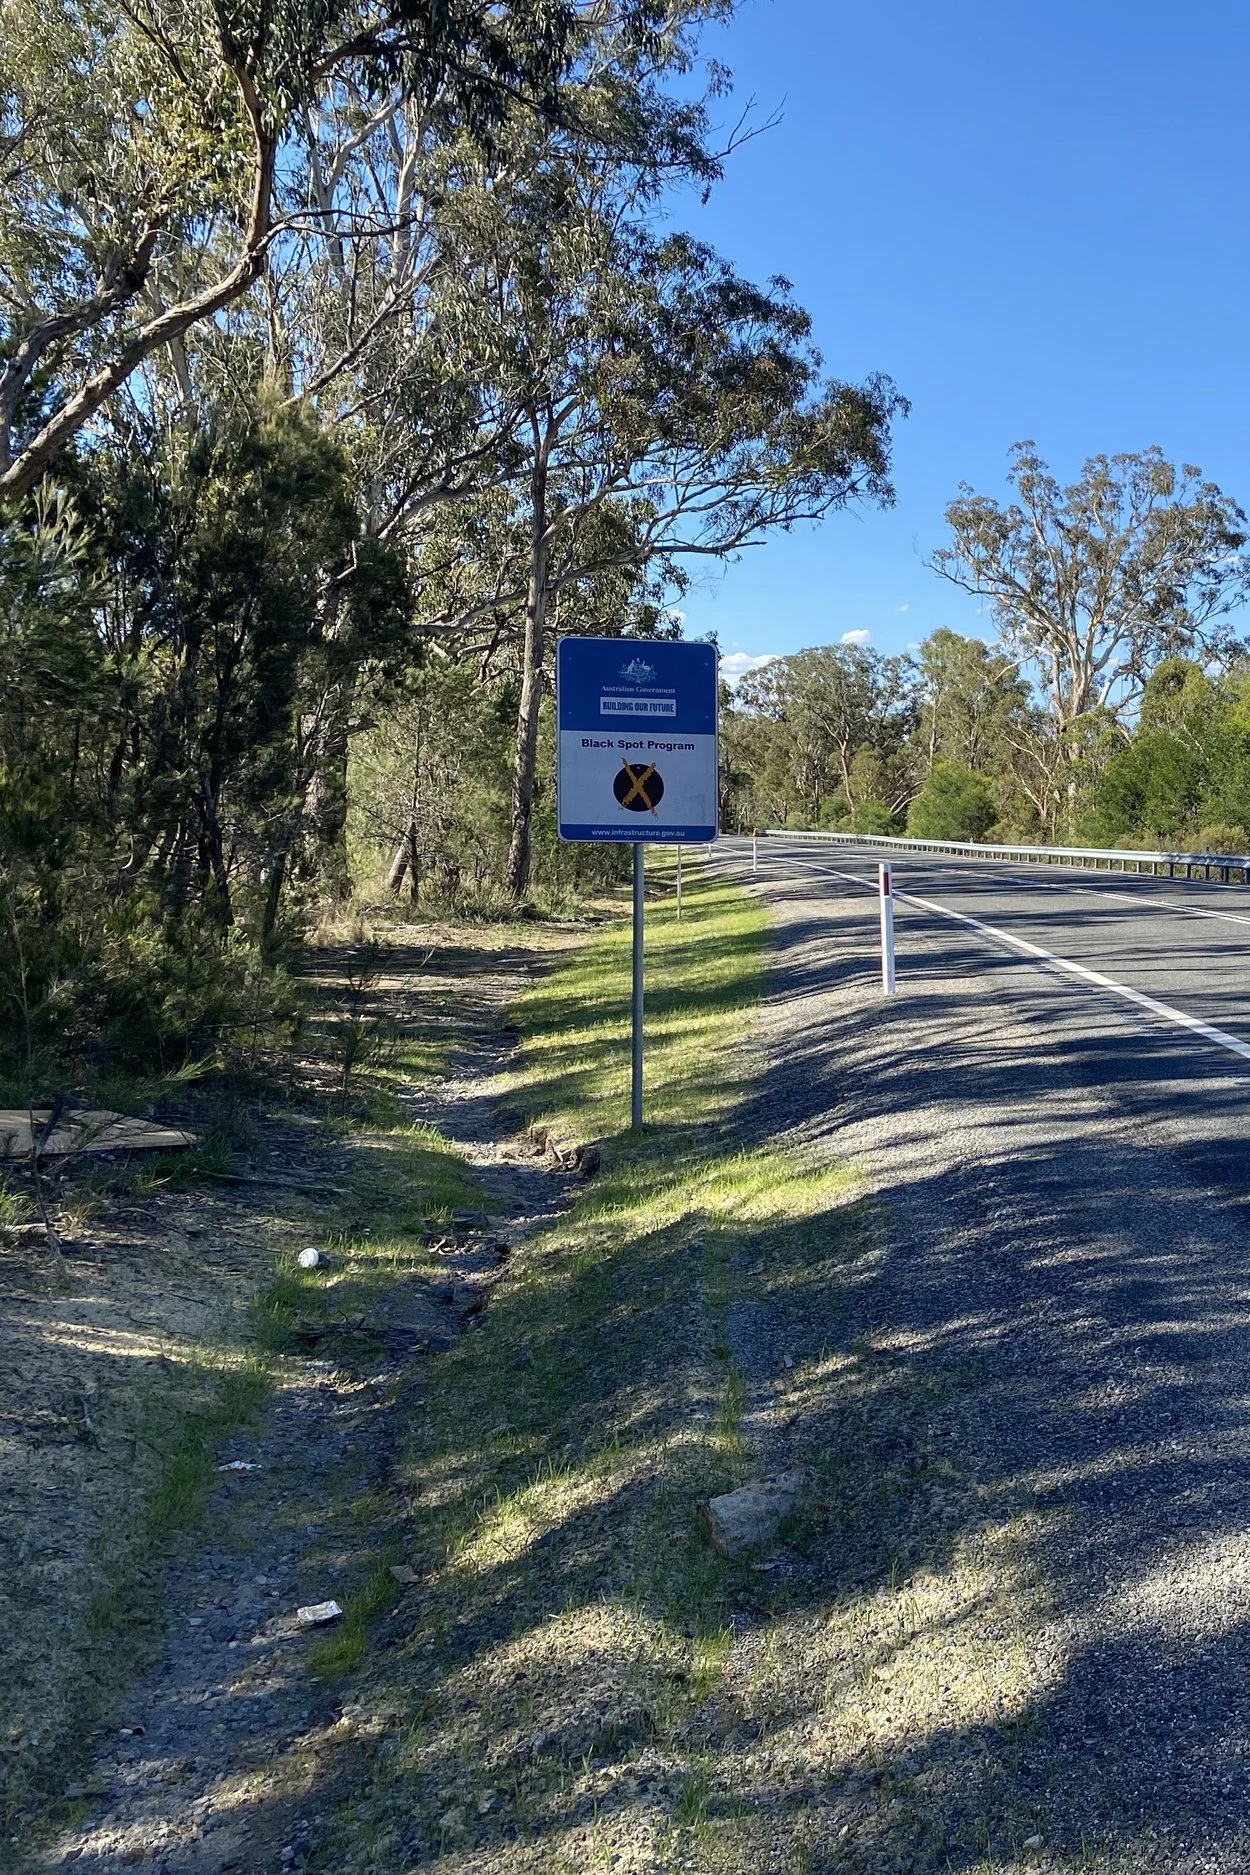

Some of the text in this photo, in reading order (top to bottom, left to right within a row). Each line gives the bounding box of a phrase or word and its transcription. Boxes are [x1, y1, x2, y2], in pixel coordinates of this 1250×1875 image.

[601, 685, 676, 694] Australian Government
[602, 701, 675, 713] BUILDING OUR FUTURE
[581, 739, 695, 752] Black Spot Program
[591, 828, 686, 838] www.infrastructure.gov.au
